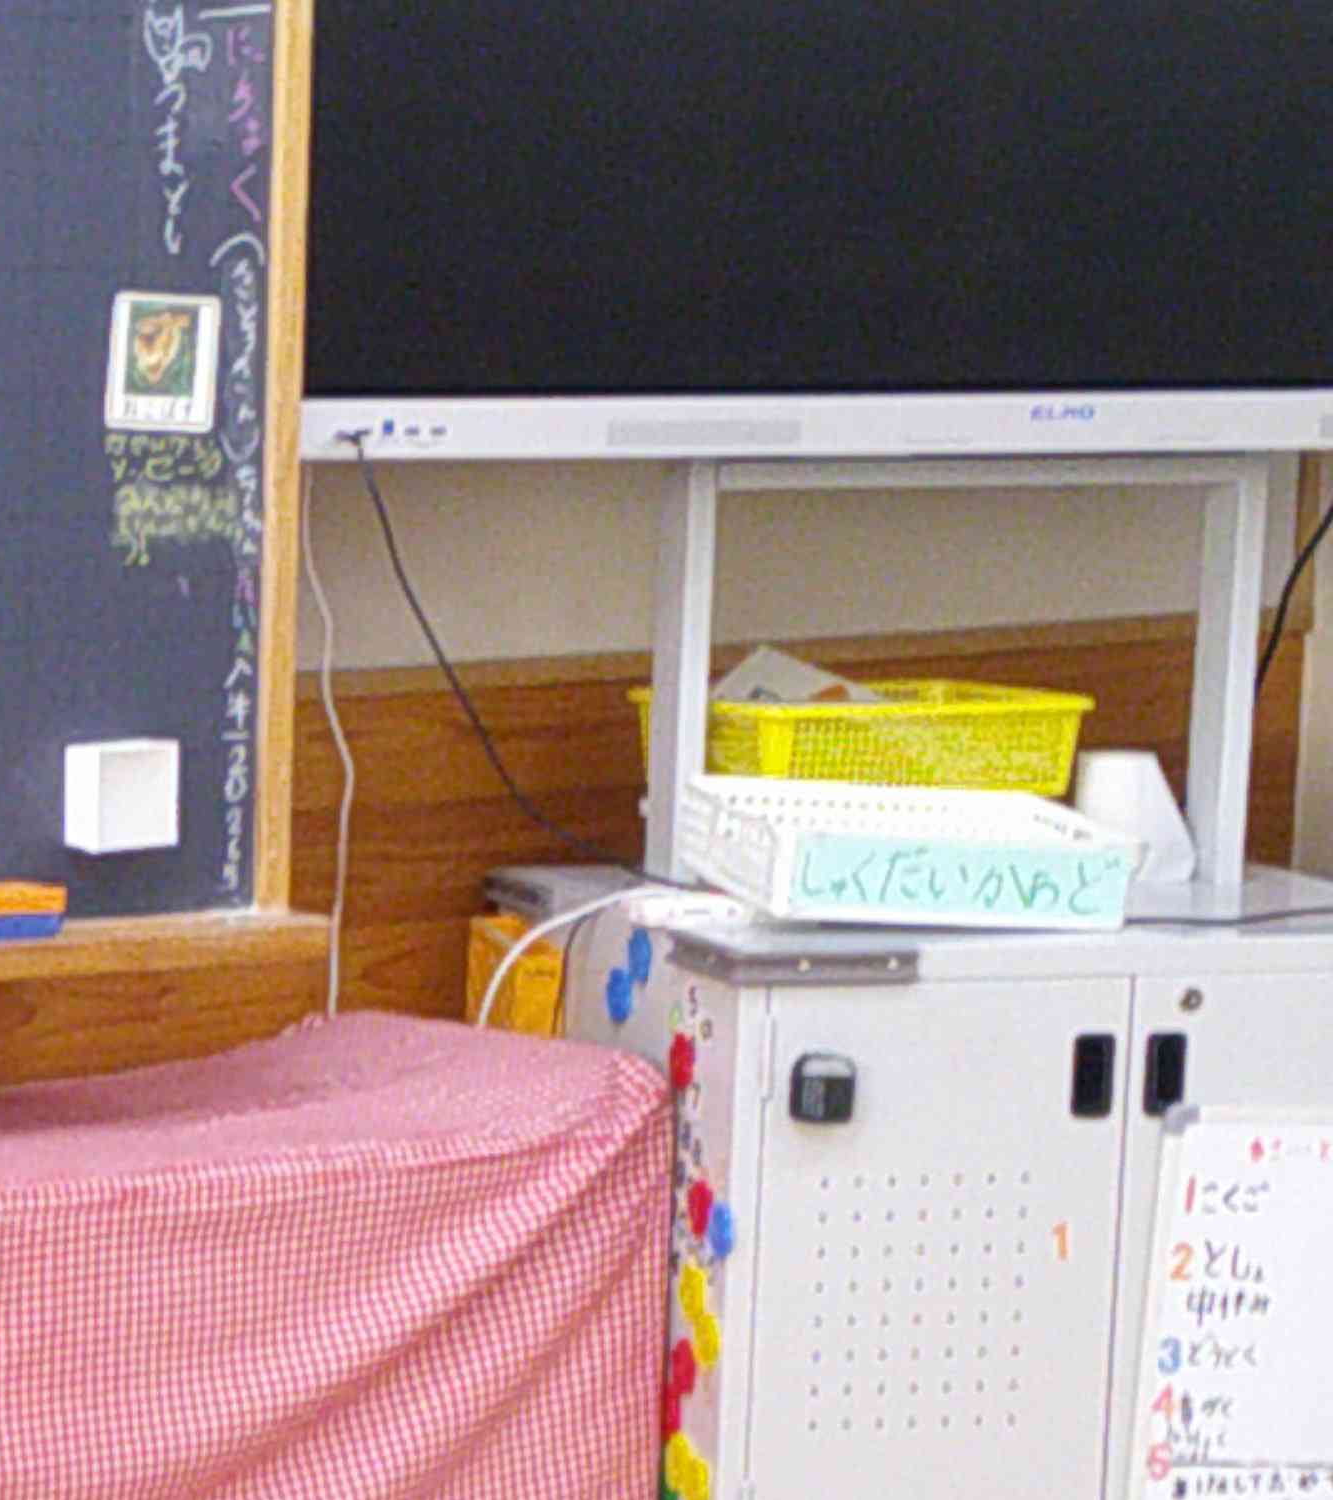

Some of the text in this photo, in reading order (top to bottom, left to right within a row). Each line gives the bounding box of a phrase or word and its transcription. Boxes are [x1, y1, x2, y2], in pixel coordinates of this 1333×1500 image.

[1052, 1222, 1069, 1260] 1
[1169, 1242, 1193, 1281] 2
[1157, 1336, 1181, 1374] 3
